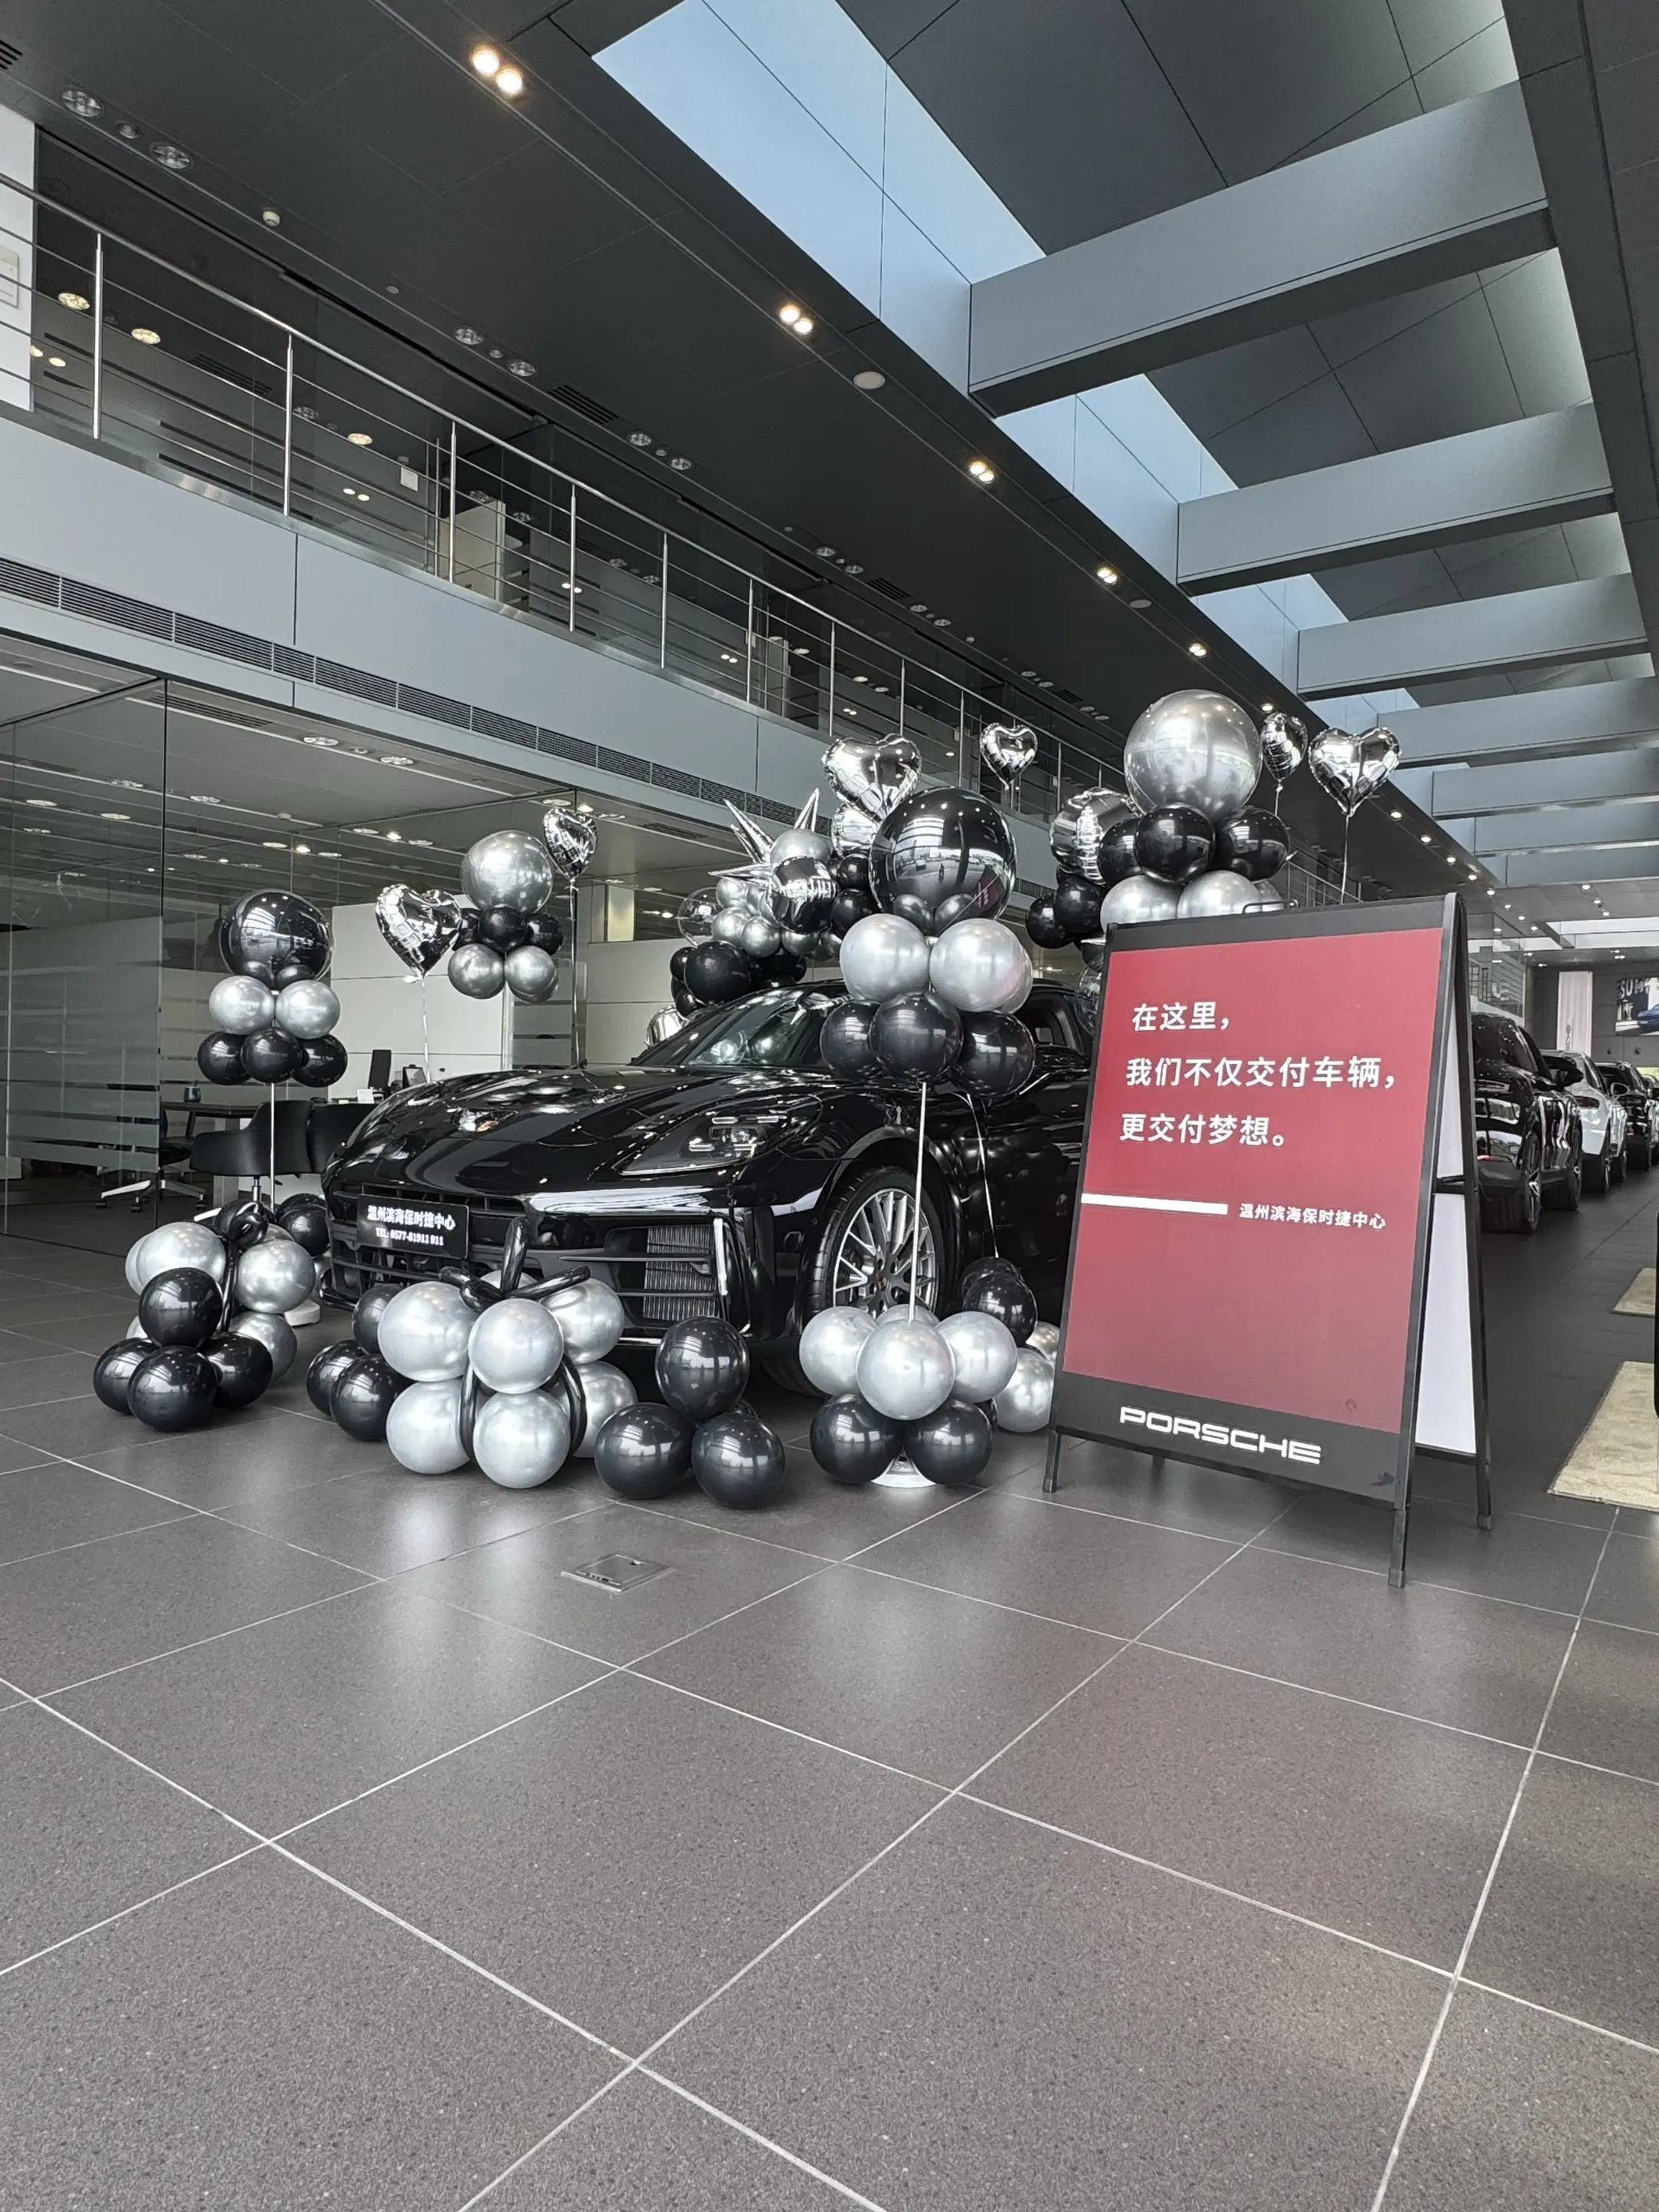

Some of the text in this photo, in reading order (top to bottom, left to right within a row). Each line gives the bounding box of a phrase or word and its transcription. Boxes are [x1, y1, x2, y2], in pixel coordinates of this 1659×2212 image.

[1132, 1001, 1230, 1031] 在这里，
[1125, 1055, 1396, 1089] 我们不仅交付车辆，
[1119, 1112, 1285, 1147] 更交付梦想。
[367, 1205, 456, 1231] 温州滨海保时捷中心
[1239, 1203, 1386, 1230] 温州滨海保时捷中心
[1119, 1406, 1322, 1465] PORSCHE
